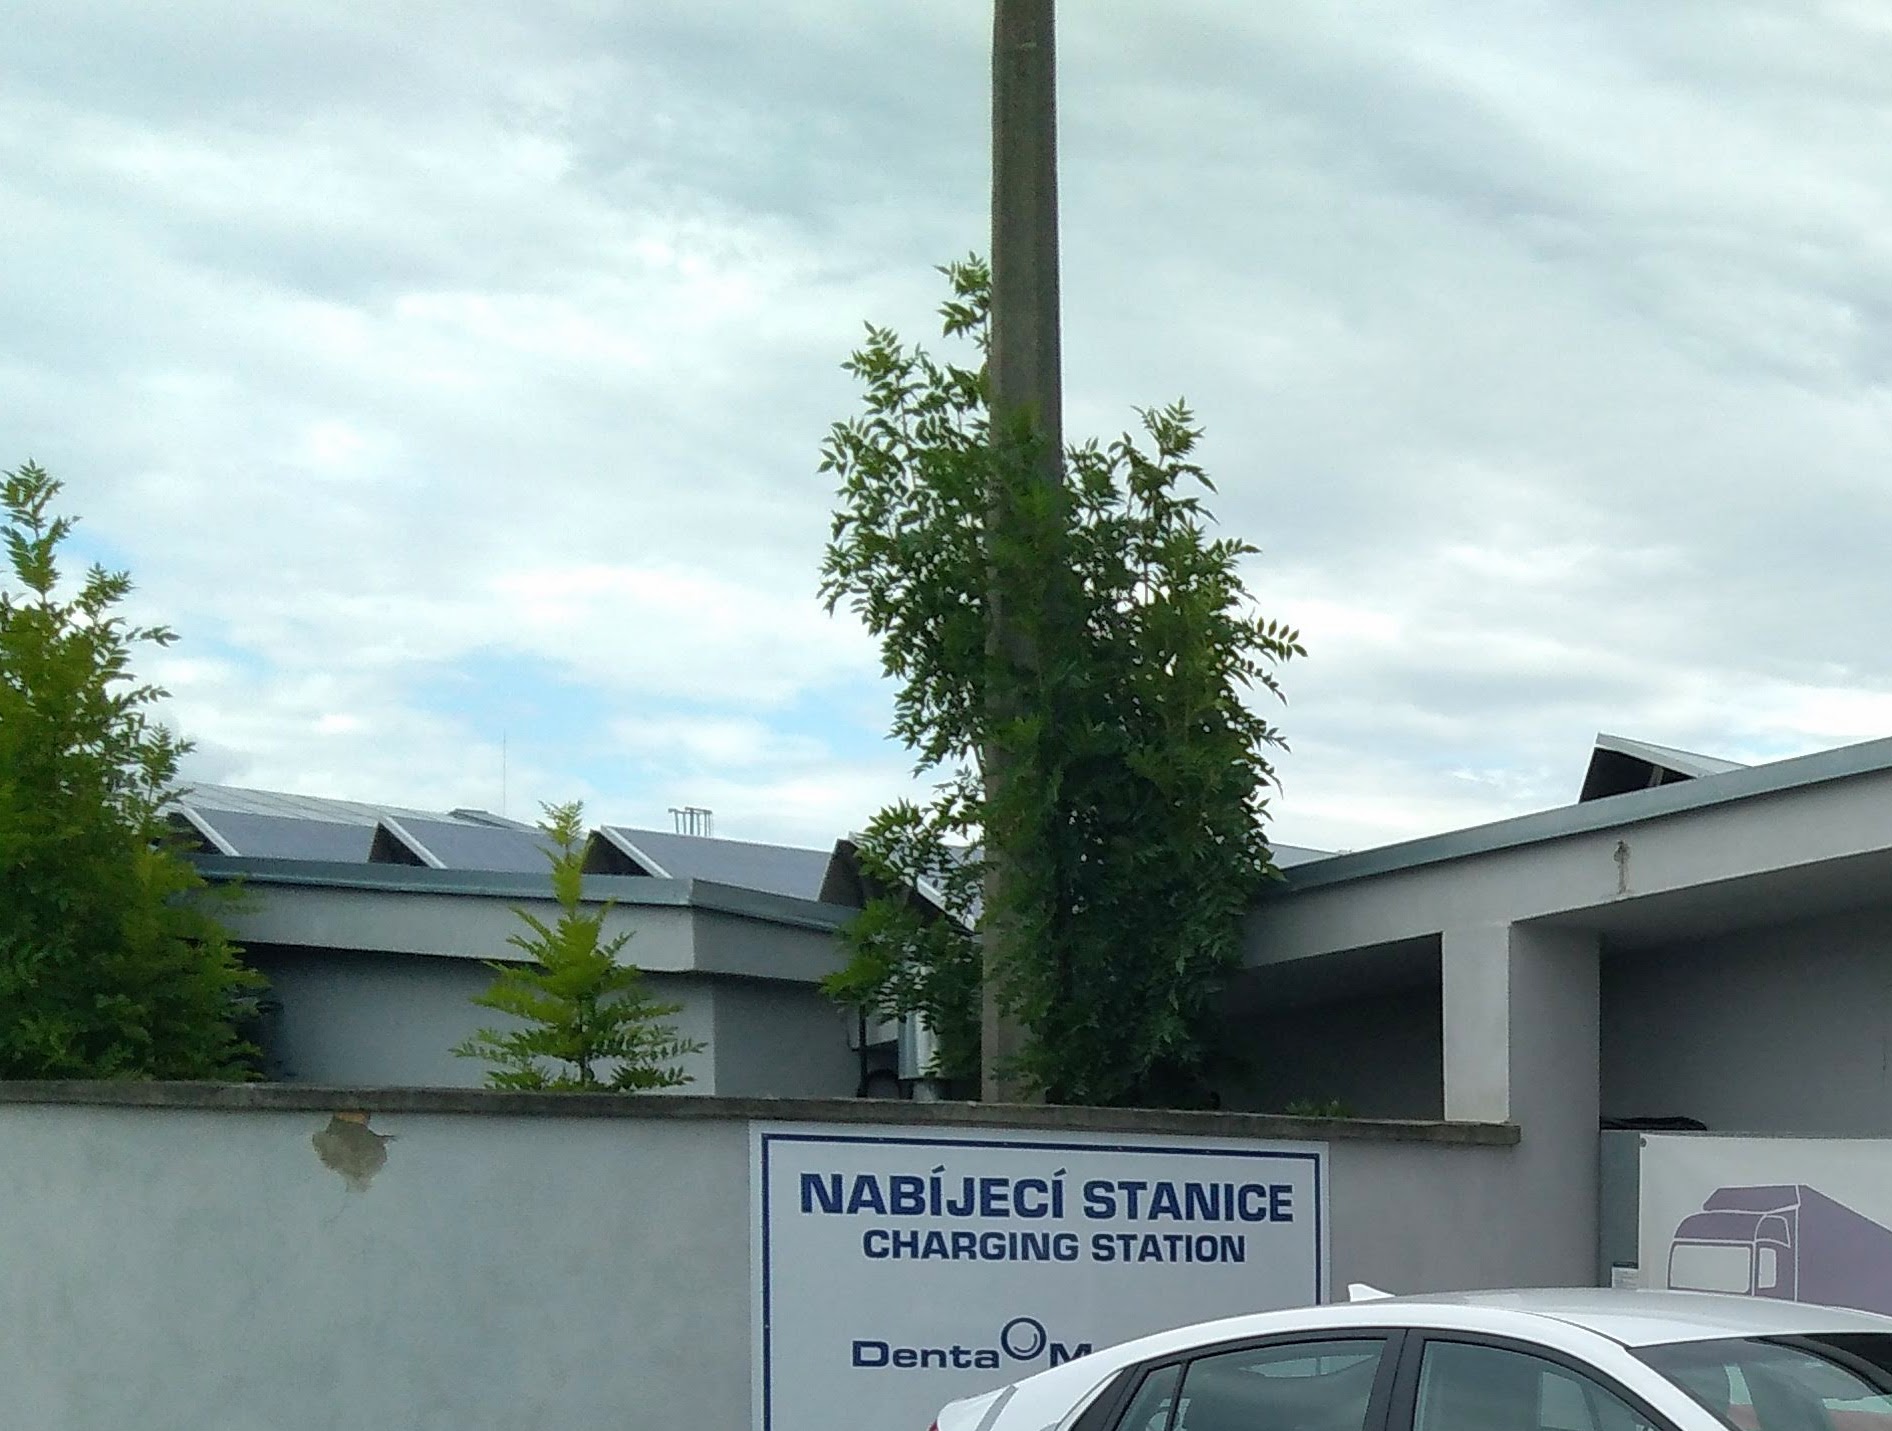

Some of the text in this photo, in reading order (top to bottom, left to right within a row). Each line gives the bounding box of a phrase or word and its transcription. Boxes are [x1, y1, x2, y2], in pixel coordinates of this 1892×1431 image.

[800, 1165, 1294, 1222] NABÍJECÍ STANICE
[862, 1229, 1246, 1263] CHARGING STATION
